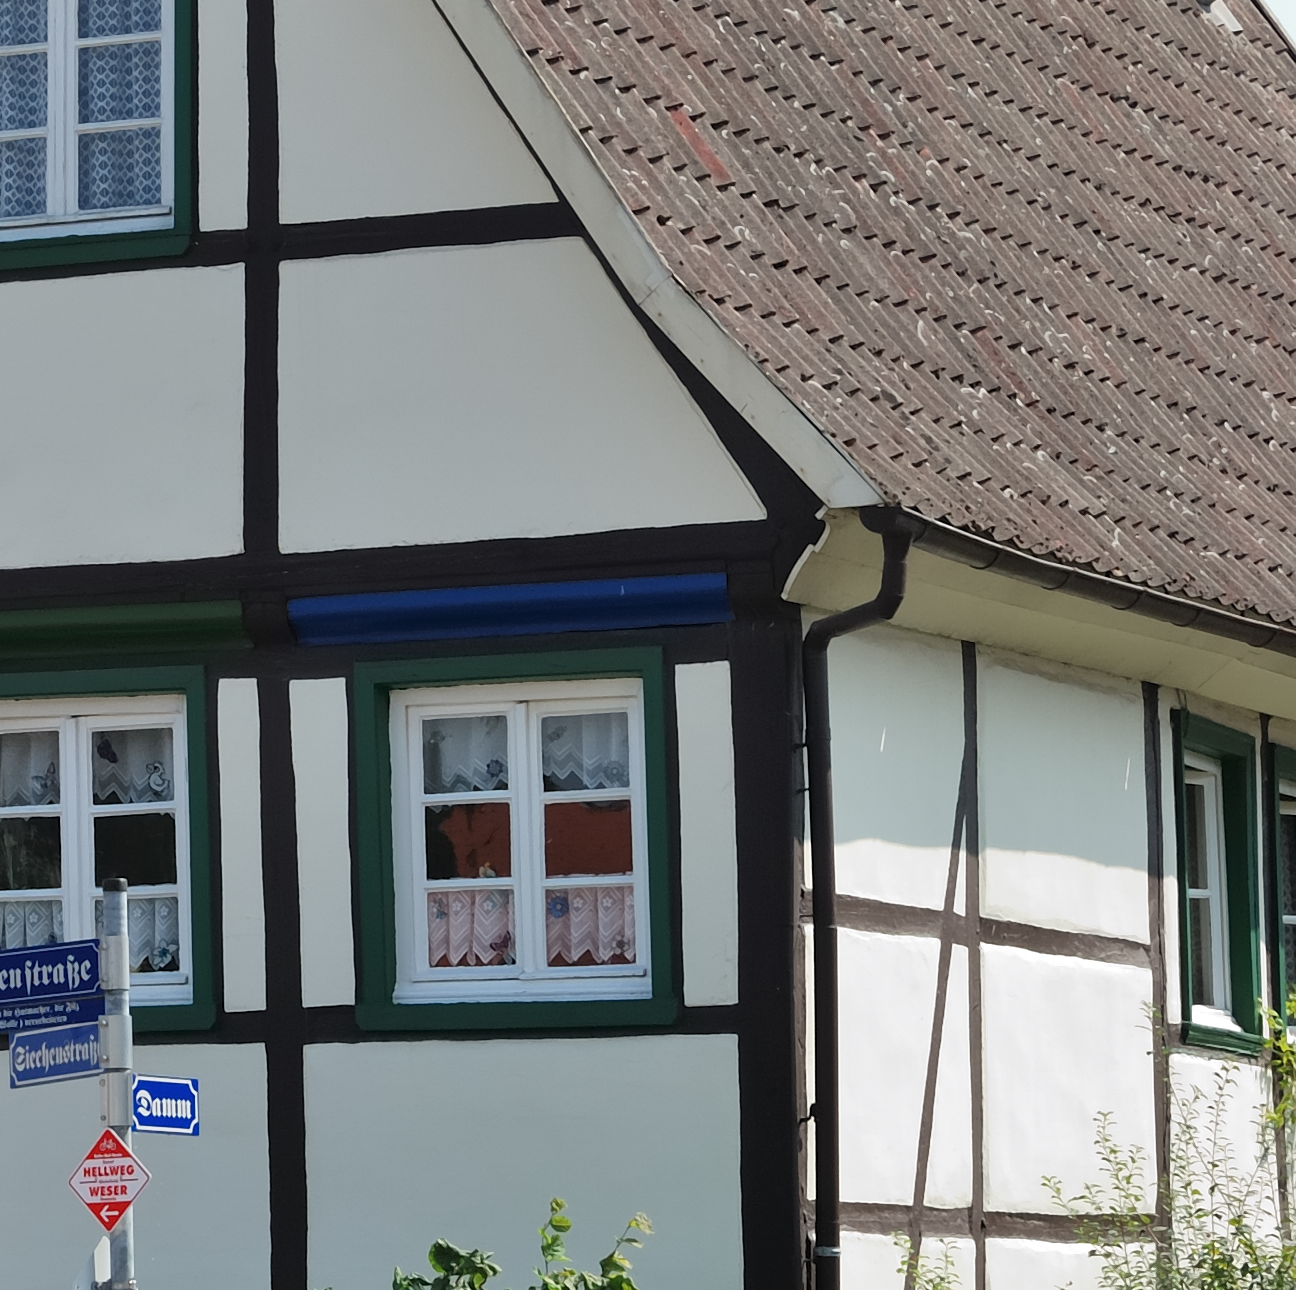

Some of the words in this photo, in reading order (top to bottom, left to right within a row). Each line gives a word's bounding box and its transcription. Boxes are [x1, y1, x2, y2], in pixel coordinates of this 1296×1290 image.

[14, 1034, 100, 1073] Siechenstraß
[135, 1089, 192, 1119] Damm
[83, 1164, 135, 1177] HELLWEG
[88, 1184, 128, 1197] WESER
